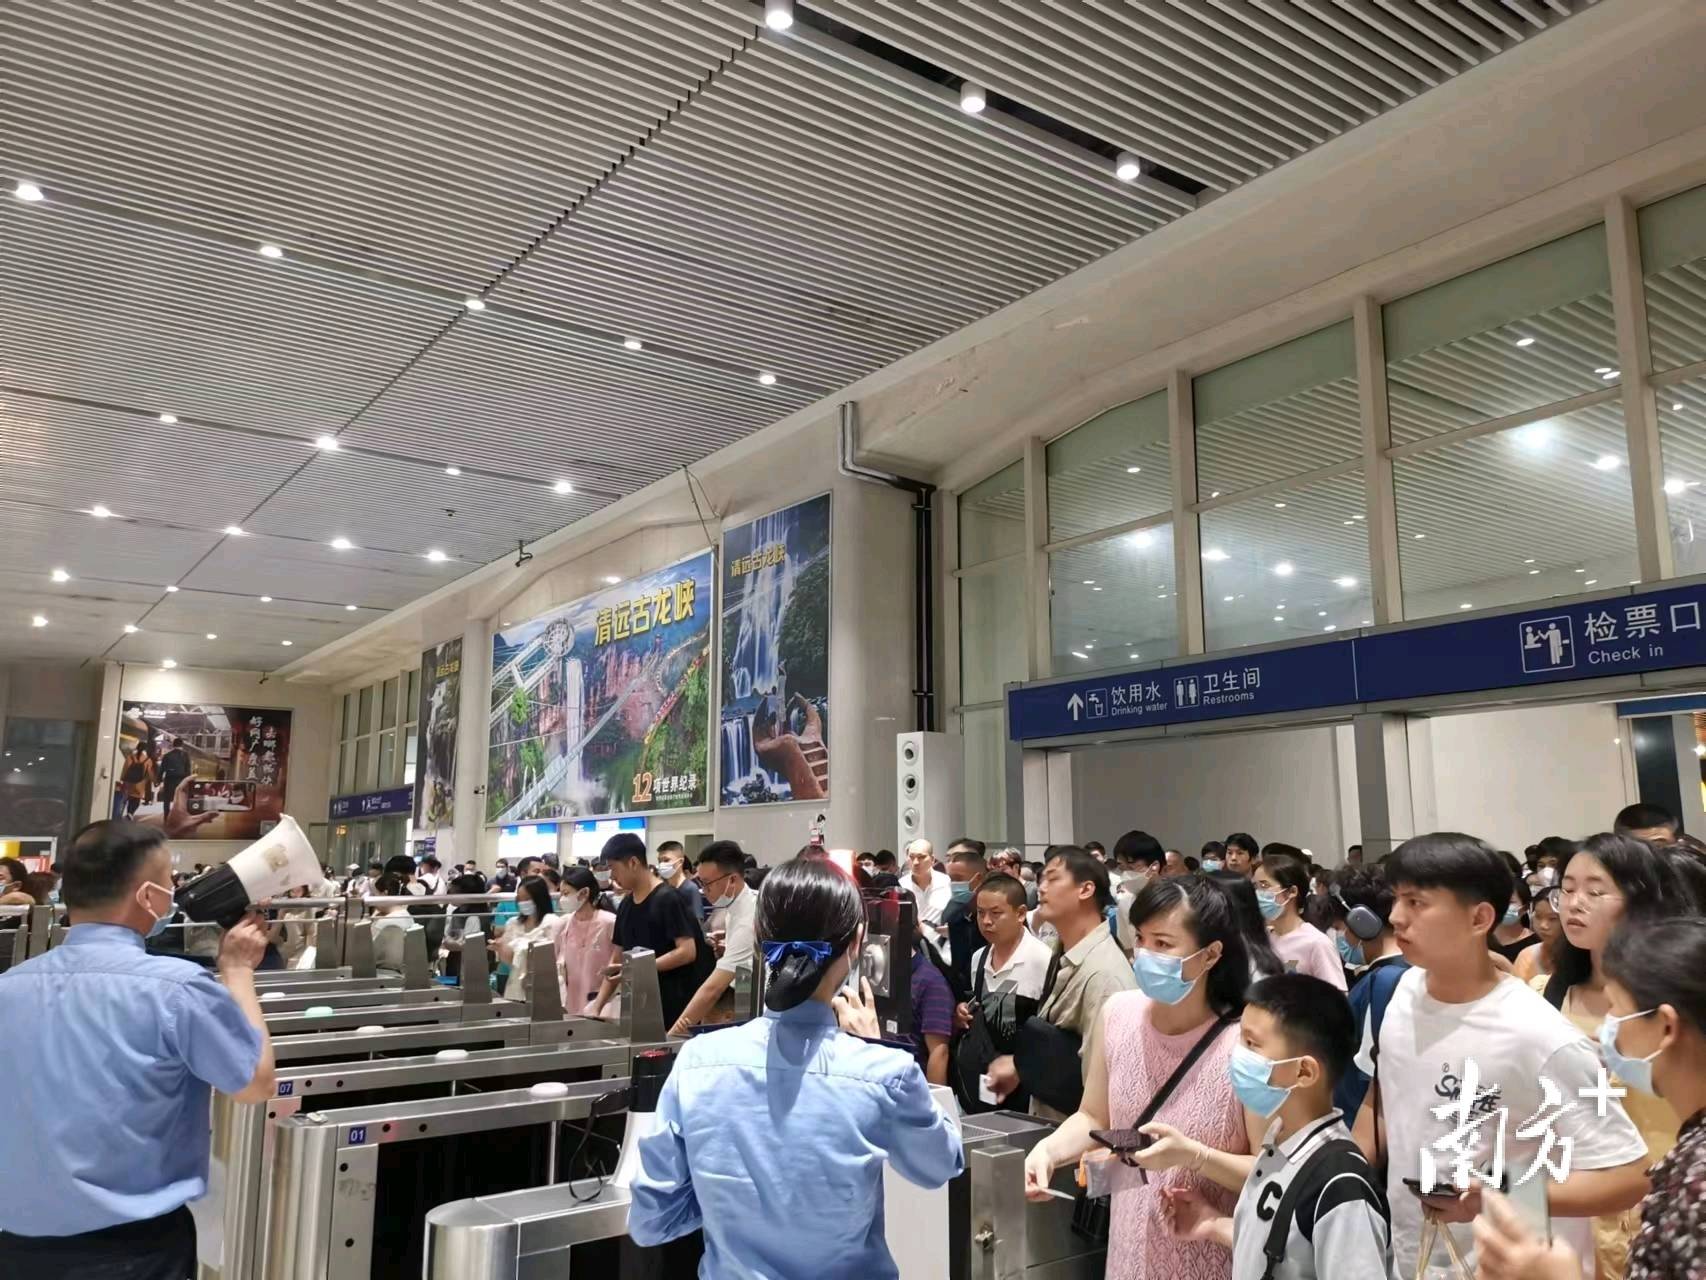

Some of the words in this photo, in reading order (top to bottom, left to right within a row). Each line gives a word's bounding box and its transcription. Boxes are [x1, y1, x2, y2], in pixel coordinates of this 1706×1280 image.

[731, 544, 785, 577] 清远古龙峡
[595, 577, 696, 647] 清远古龙峡
[1584, 602, 1701, 645] 检票口
[1588, 647, 1641, 664] Check
[1649, 644, 1664, 657] in
[1203, 667, 1261, 695] 卫生间
[1111, 681, 1161, 705] 饮用水
[1203, 692, 1255, 705] Restrooms
[1111, 703, 1143, 716] Drinking
[1145, 702, 1168, 712] water
[279, 1083, 291, 1094] 07
[350, 1130, 364, 1142] 01
